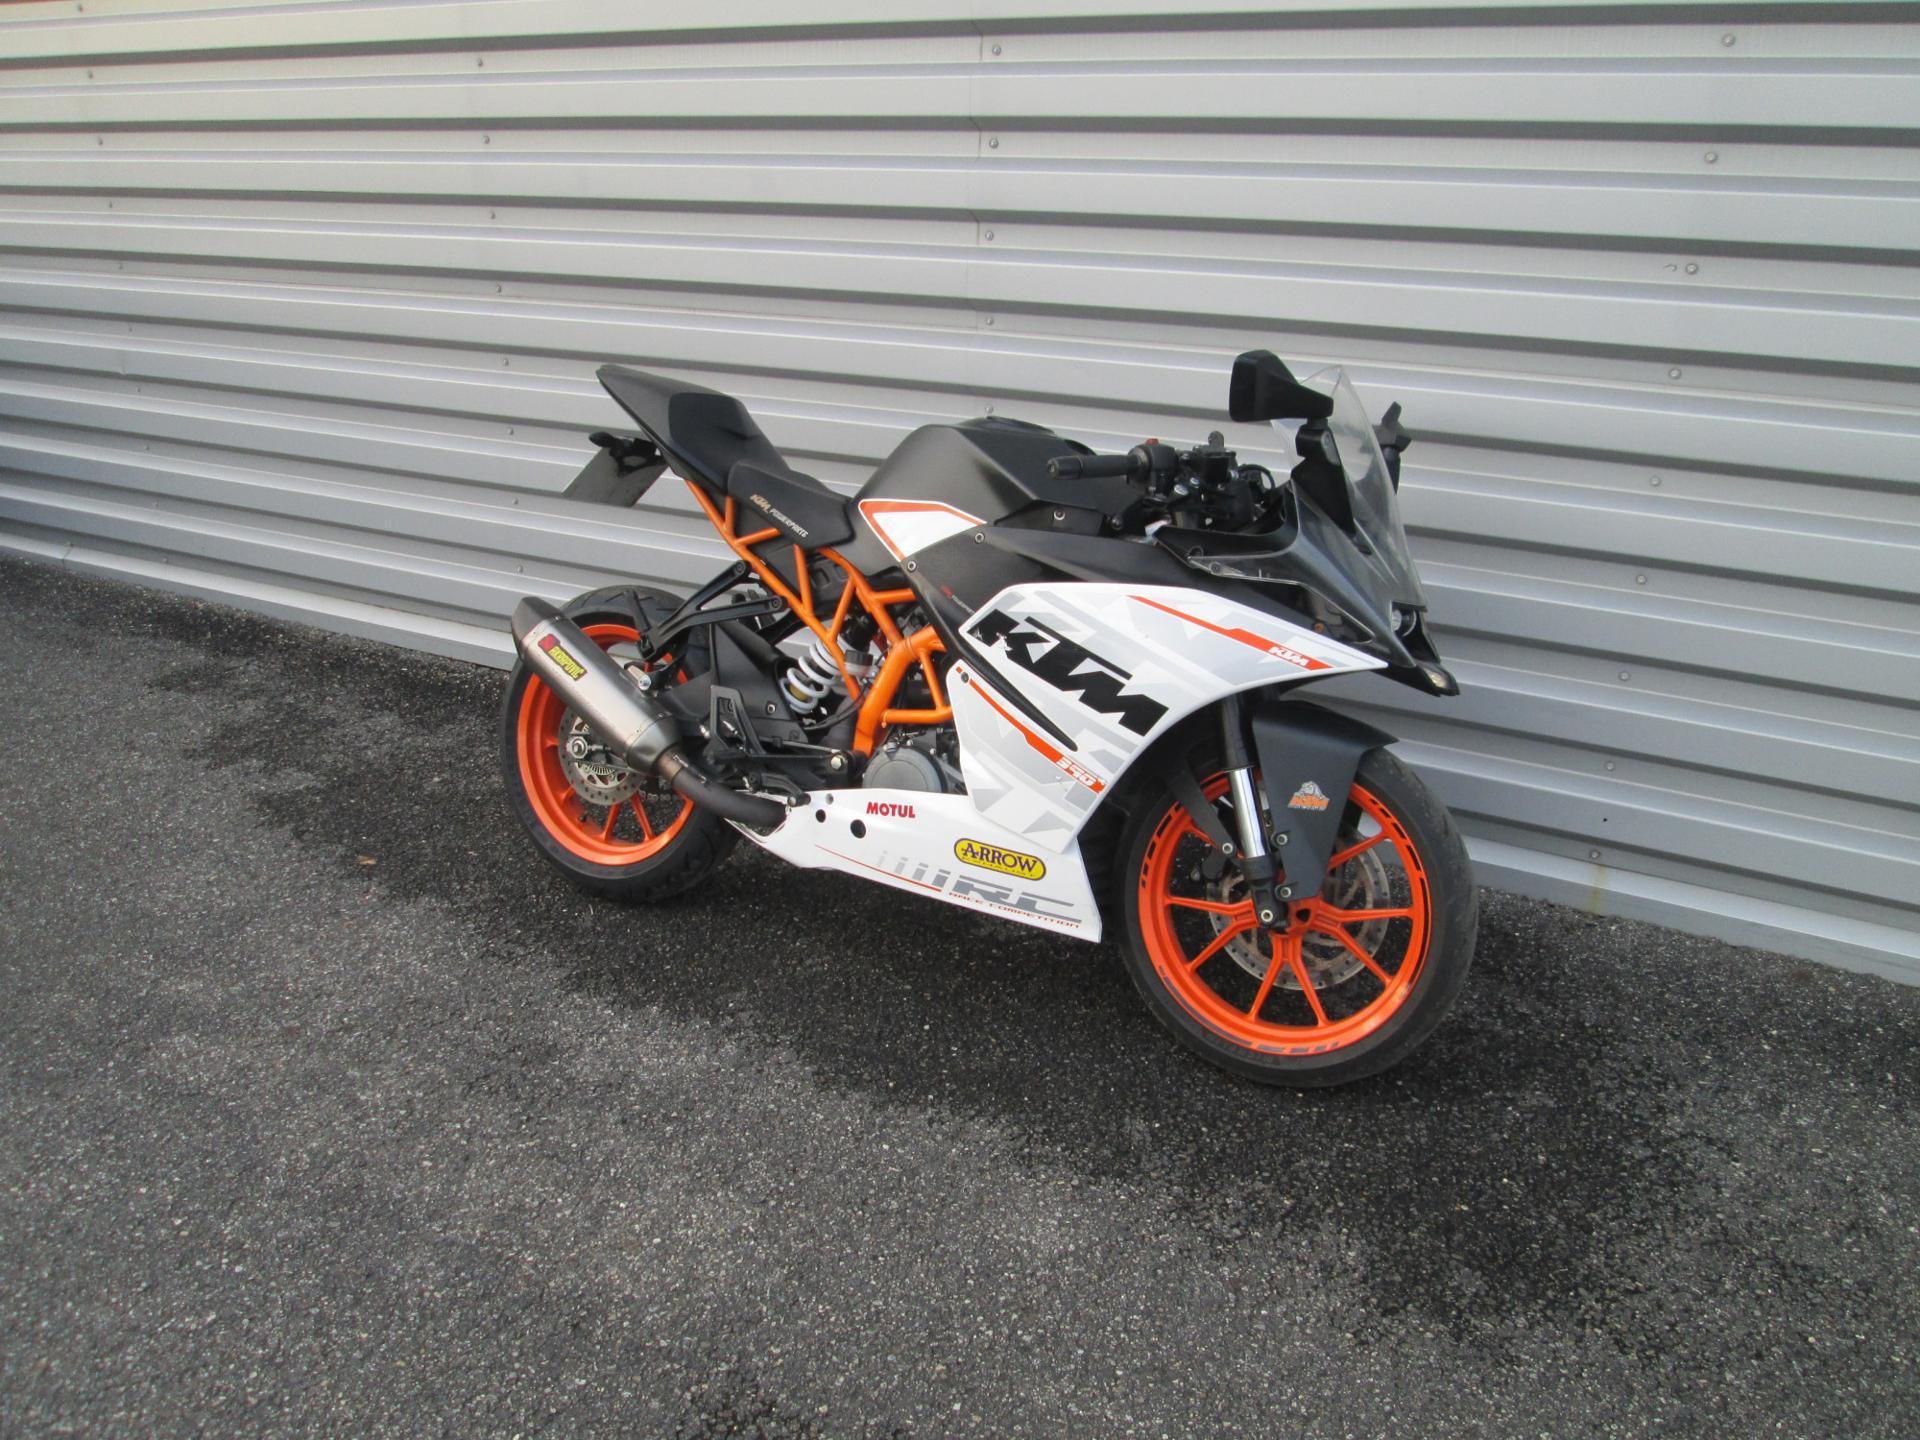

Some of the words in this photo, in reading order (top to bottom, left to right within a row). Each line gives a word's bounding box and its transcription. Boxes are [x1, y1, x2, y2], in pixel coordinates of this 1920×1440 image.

[1268, 646, 1309, 667] KTM
[966, 608, 1169, 737] KTM
[1056, 757, 1097, 787] 390
[866, 801, 916, 818] MOTUL
[960, 842, 1038, 872] ARROW
[952, 874, 1083, 924] RC
